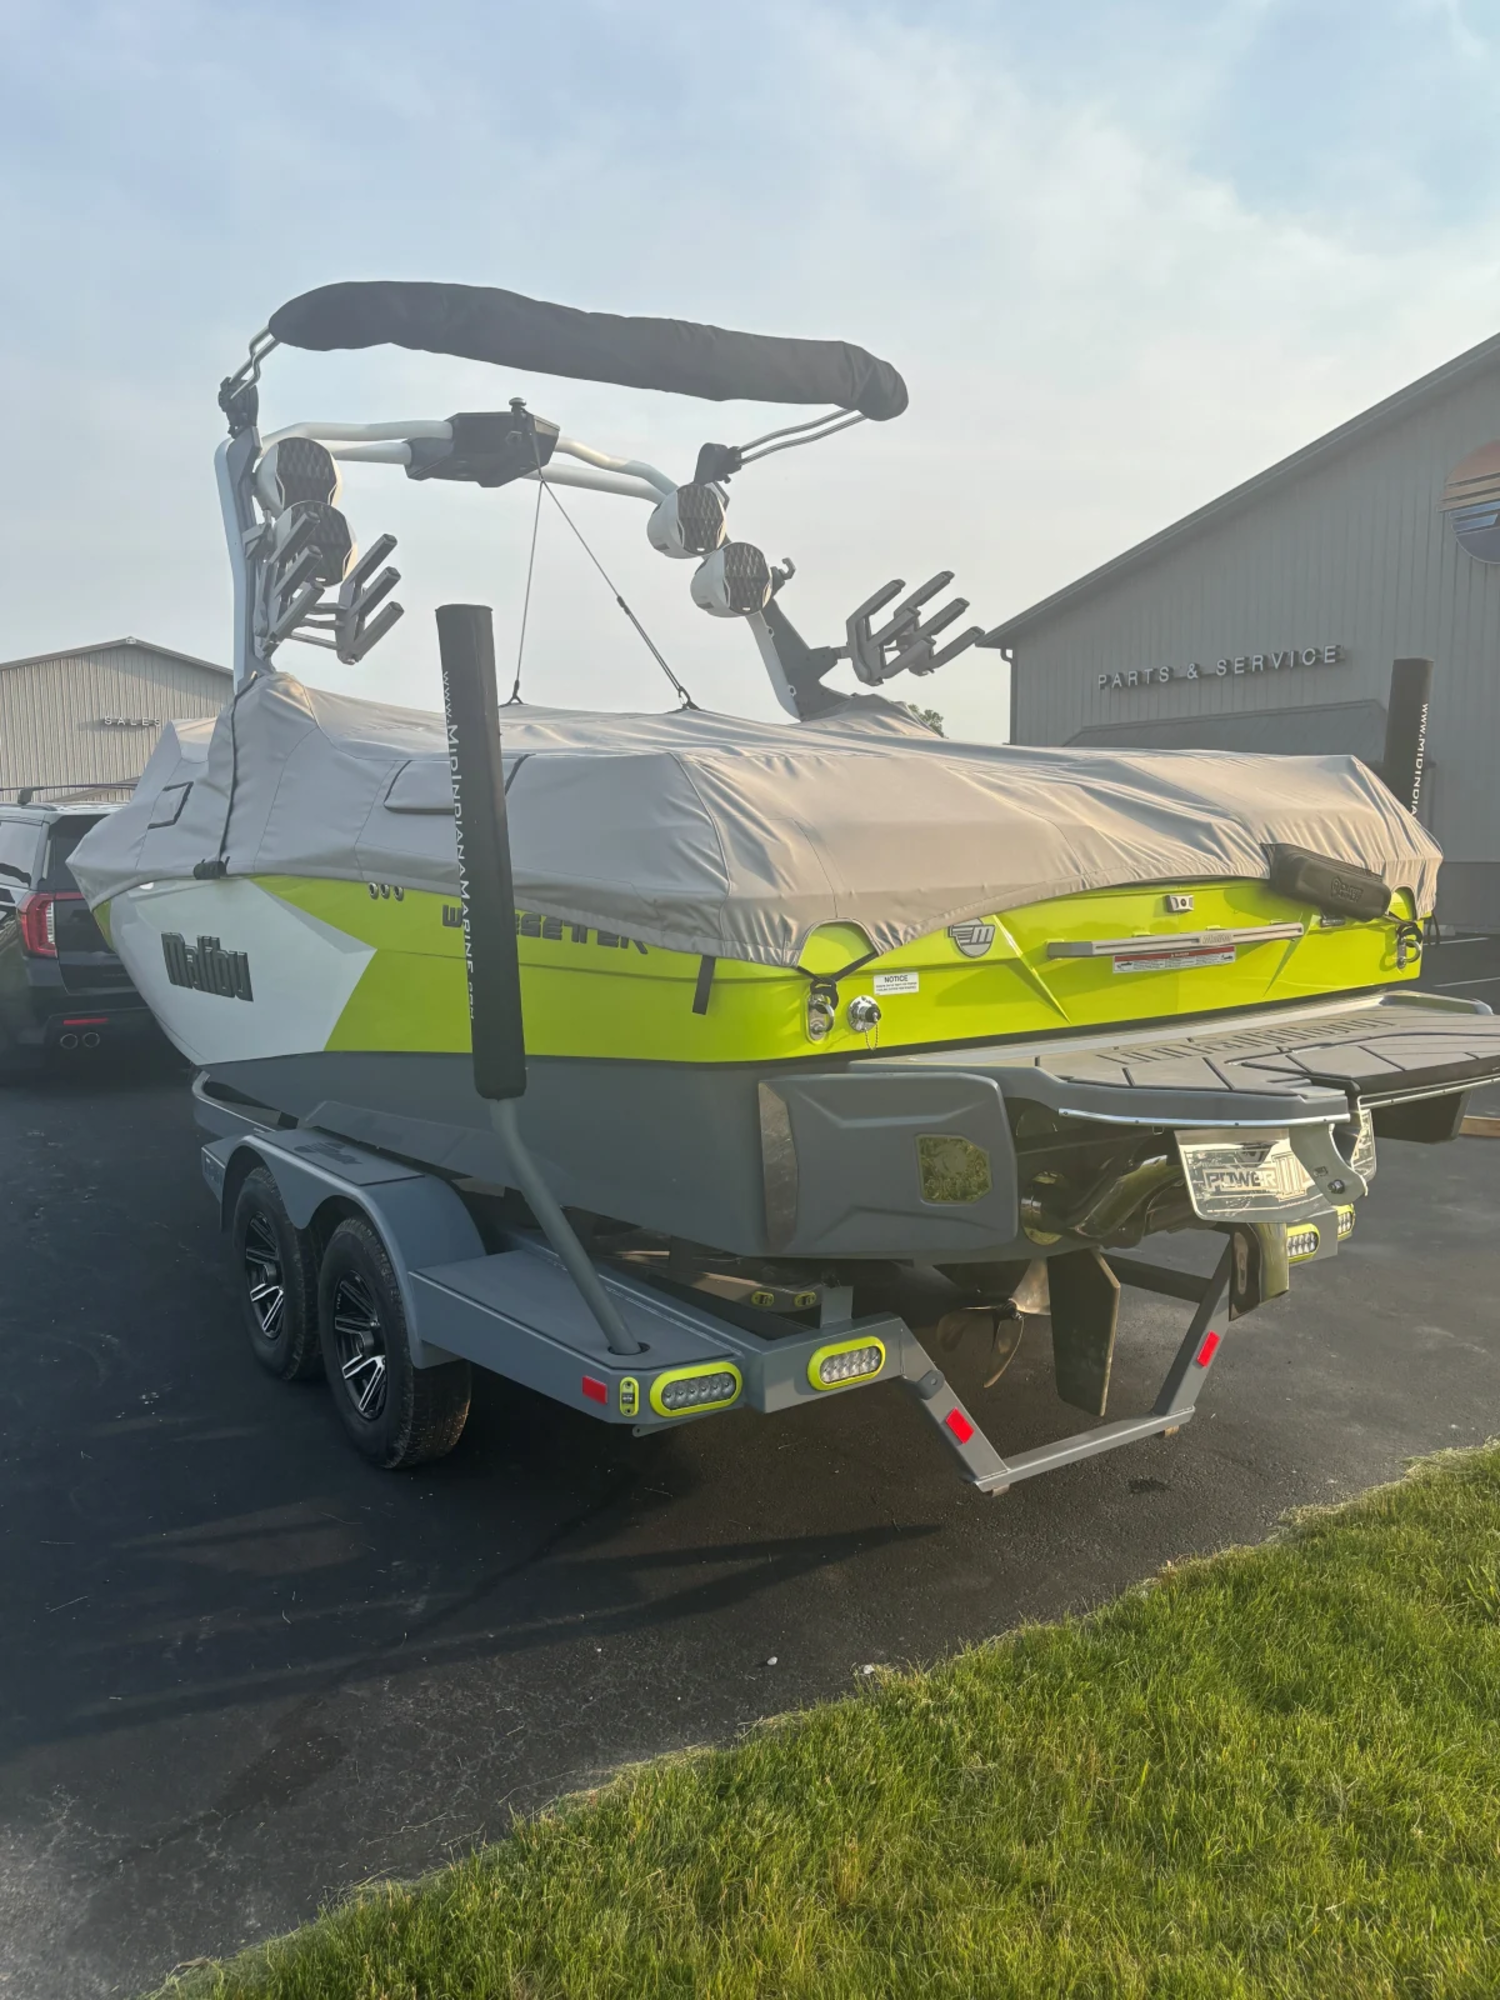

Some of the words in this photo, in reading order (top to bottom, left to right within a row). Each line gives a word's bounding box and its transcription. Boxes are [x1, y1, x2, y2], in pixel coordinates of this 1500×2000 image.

[1098, 665, 1170, 690] PARTS
[1187, 662, 1199, 680] &
[1215, 644, 1337, 677] SERVICE
[104, 716, 161, 727] SALES
[161, 931, 254, 1003] Malibu
[884, 974, 908, 983] NOTICE
[1205, 1169, 1279, 1191] POWER
